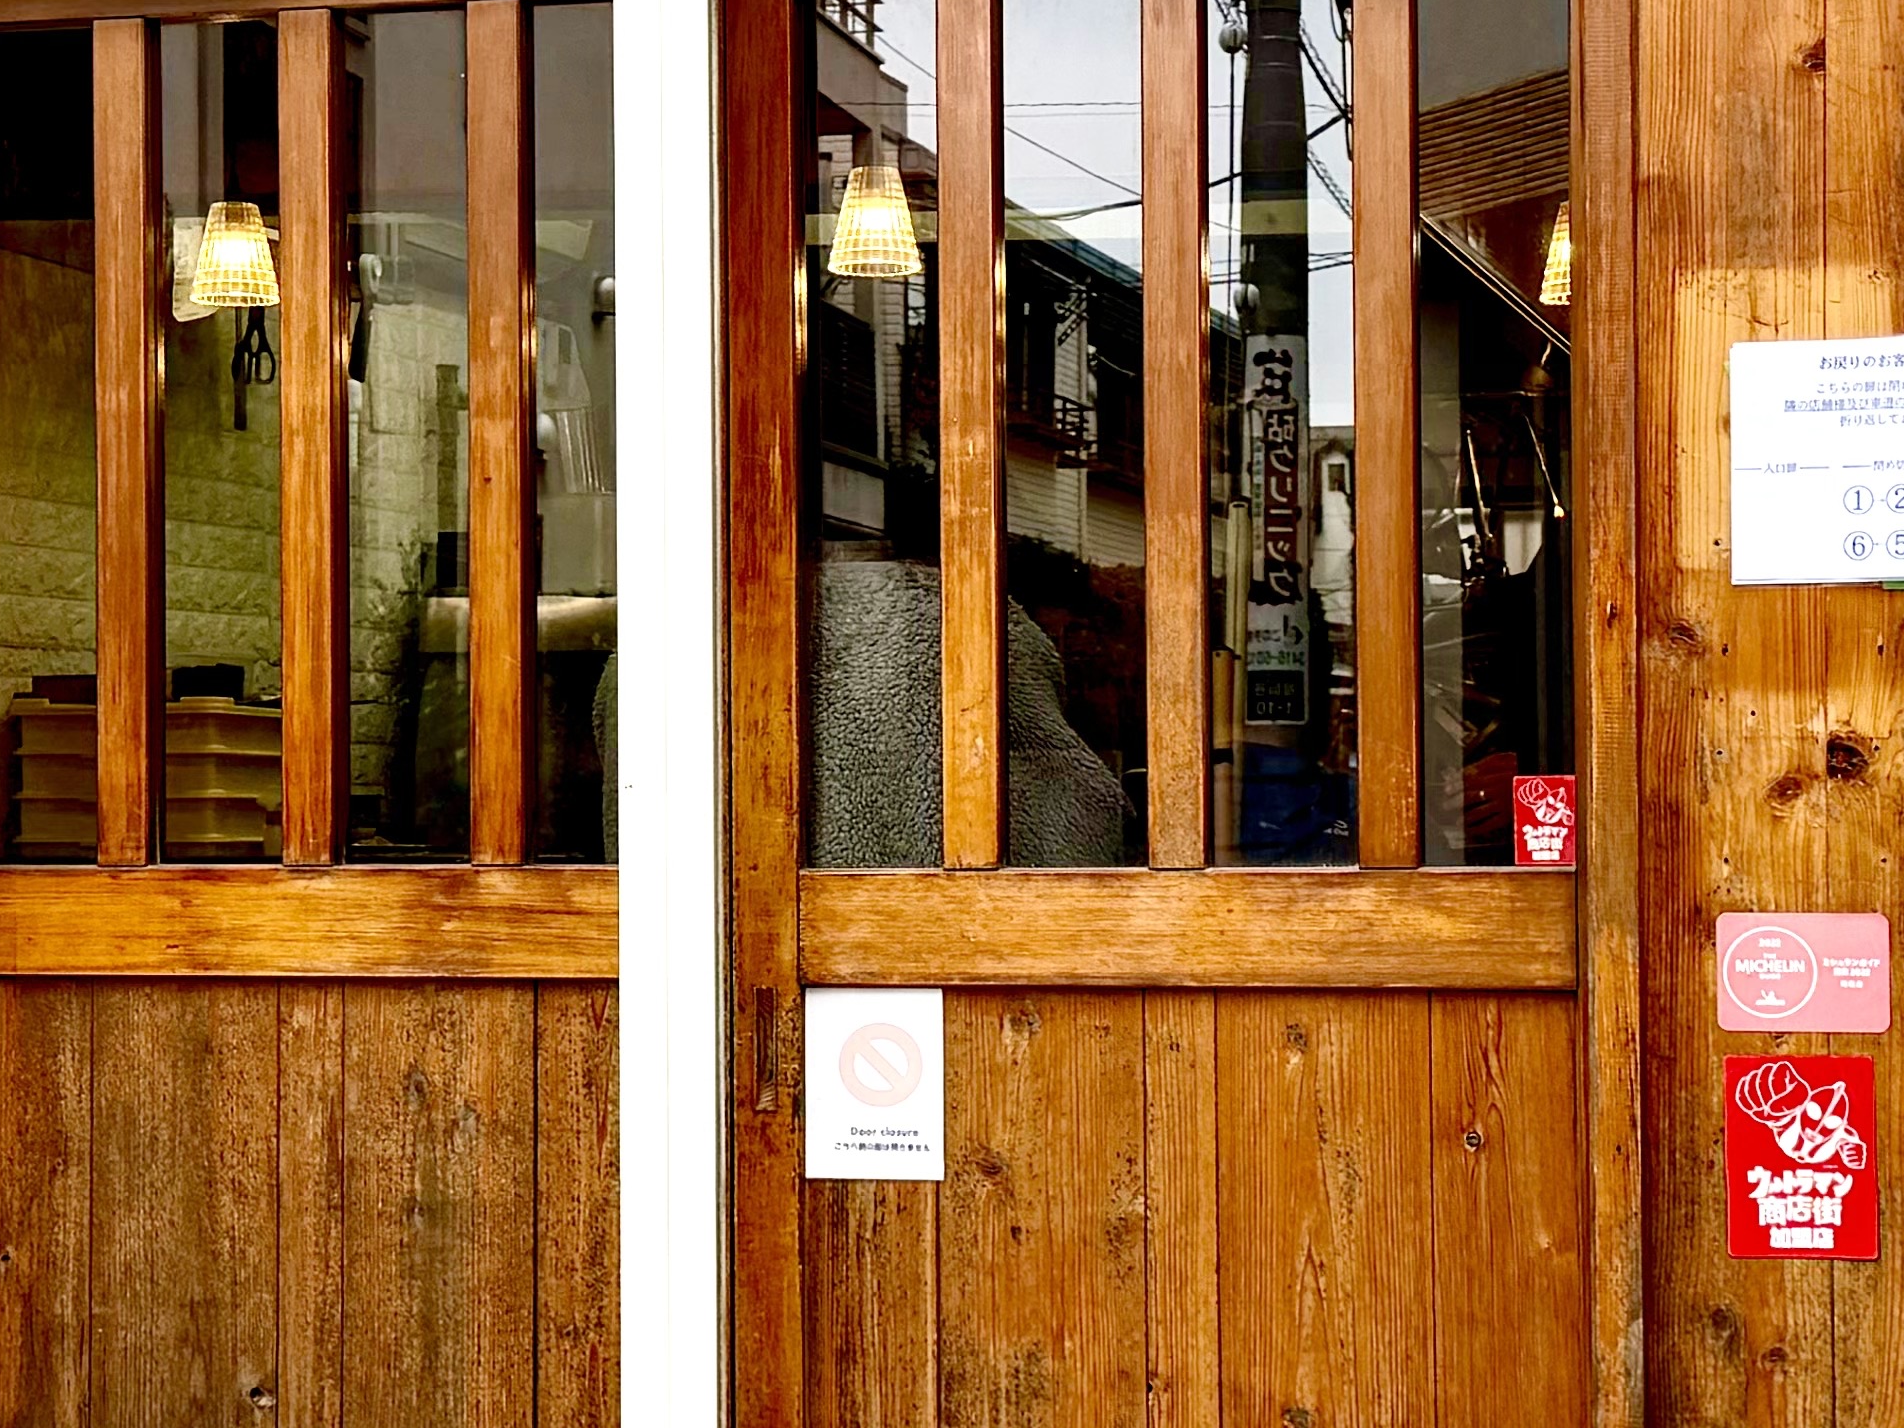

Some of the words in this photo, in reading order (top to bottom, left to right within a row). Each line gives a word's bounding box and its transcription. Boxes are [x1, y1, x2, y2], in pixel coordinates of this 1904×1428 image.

[1735, 959, 1806, 974] MICHELIN
[850, 1126, 877, 1136] Door
[1746, 1165, 1854, 1200] ウルトラマン
[1756, 1195, 1843, 1227] 商店街
